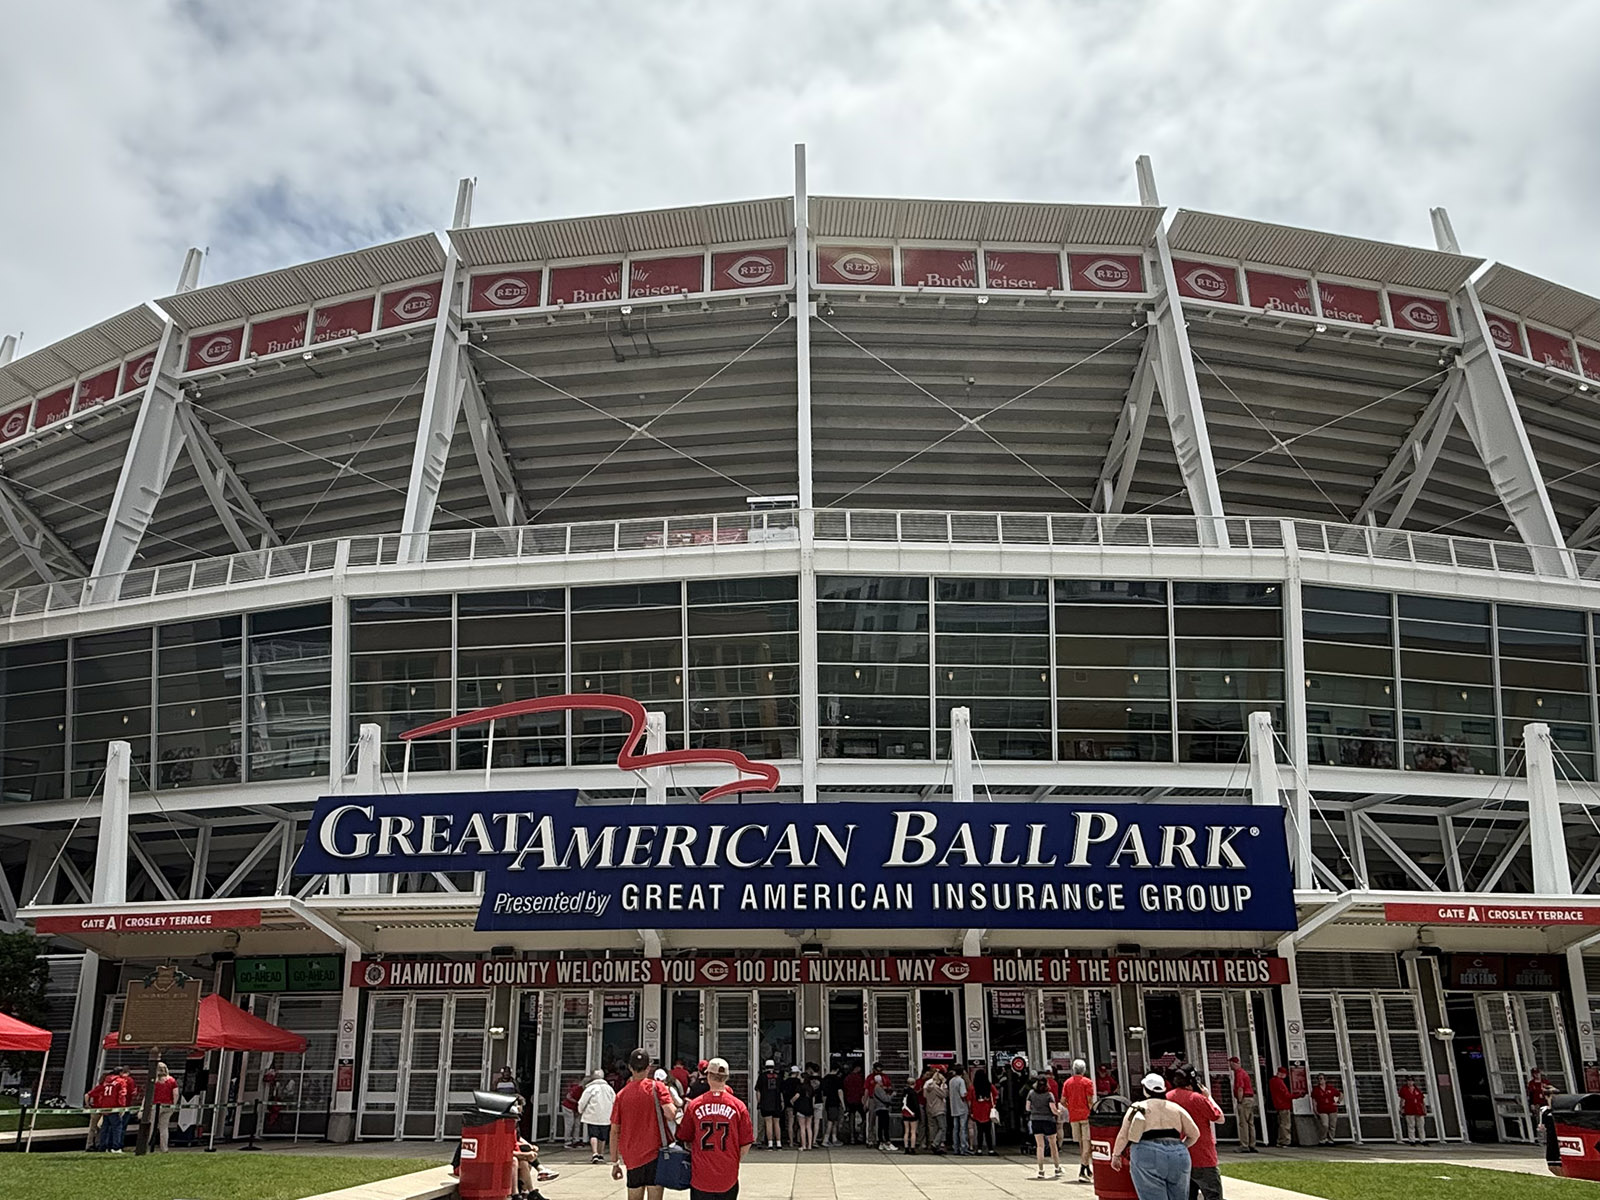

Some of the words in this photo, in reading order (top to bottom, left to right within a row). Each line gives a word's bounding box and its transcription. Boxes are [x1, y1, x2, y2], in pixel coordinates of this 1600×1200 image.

[740, 264, 772, 276] REDS
[845, 262, 878, 273] REDS
[926, 273, 1037, 289] Budweiser
[1096, 270, 1129, 281] REDS
[496, 286, 528, 298] REDS
[1197, 278, 1226, 291] REDS
[572, 284, 680, 304] Budweiser
[405, 299, 433, 313] REDS
[1267, 297, 1363, 323] Budweiser
[207, 341, 233, 356] REDS
[318, 804, 534, 859] GREAT
[506, 813, 859, 872] AMERICAN
[882, 810, 1058, 869] BALL
[494, 891, 582, 915] Presented
[581, 891, 612, 918] by
[621, 884, 724, 911] GREAT
[740, 883, 913, 911] AMERICAN
[932, 883, 1126, 911] INSURANCE
[1140, 884, 1252, 912] GROUP
[1438, 908, 1465, 919] GATE
[1467, 906, 1480, 921] A
[1487, 909, 1535, 920] CROSLEY
[1536, 910, 1584, 921] TERRACE
[81, 918, 105, 930] GATE
[105, 915, 116, 930] A
[124, 916, 167, 928] CROSLEY
[169, 914, 212, 926] TERRACE
[240, 971, 282, 983] GO-AHEAD
[293, 969, 336, 981] GO-AHEAD
[390, 961, 477, 985] HAMILTON
[482, 960, 550, 985] COUNTY
[556, 959, 652, 984] WELCOMES
[660, 959, 696, 983] YOU
[708, 966, 729, 975] REDS
[734, 959, 766, 983] 100
[772, 959, 800, 982] JOE
[808, 958, 891, 982] NUXHALL
[896, 958, 937, 982] WAY
[993, 958, 1045, 982] HOME
[1049, 958, 1072, 982] OF
[1077, 958, 1112, 982] THE
[1117, 958, 1219, 982] CINCINNATI
[1224, 958, 1271, 982] REDS
[695, 1103, 737, 1120] STEWART
[700, 1120, 730, 1152] 27
